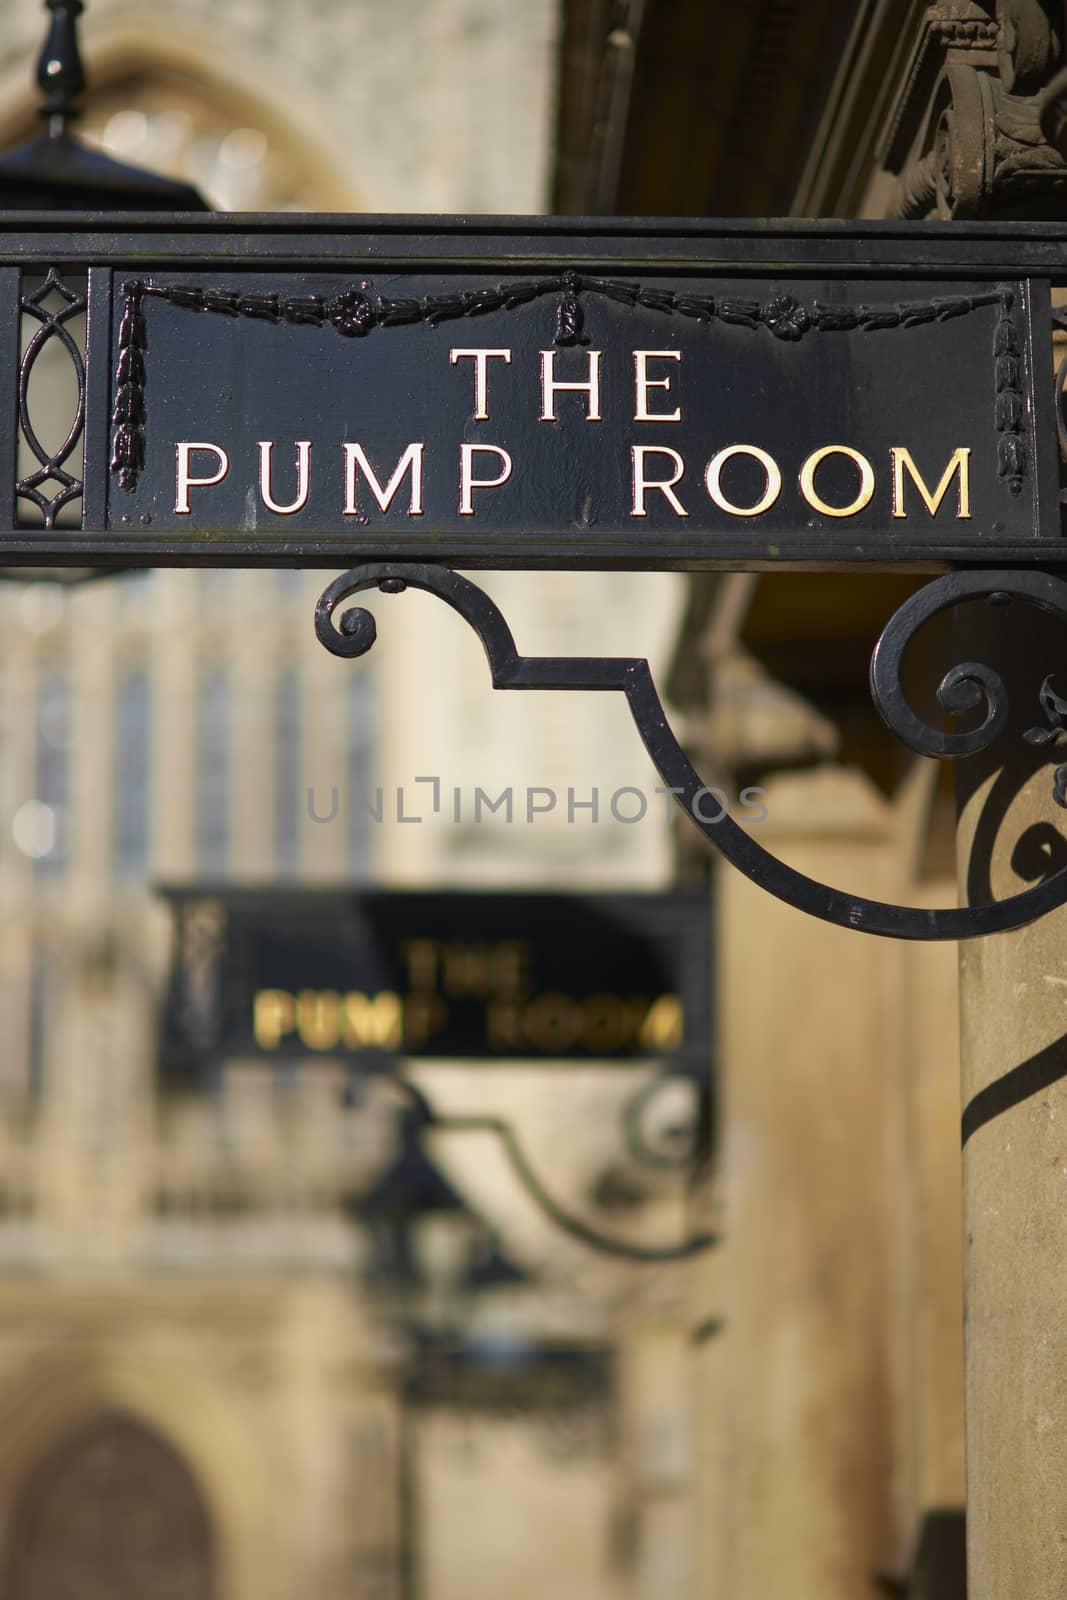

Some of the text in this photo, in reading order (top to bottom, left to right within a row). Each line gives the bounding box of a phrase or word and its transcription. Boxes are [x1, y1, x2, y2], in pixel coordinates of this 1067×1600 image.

[450, 347, 682, 422] THE
[174, 440, 972, 519] PUMP ROOM
[253, 987, 447, 1052] PUMP
